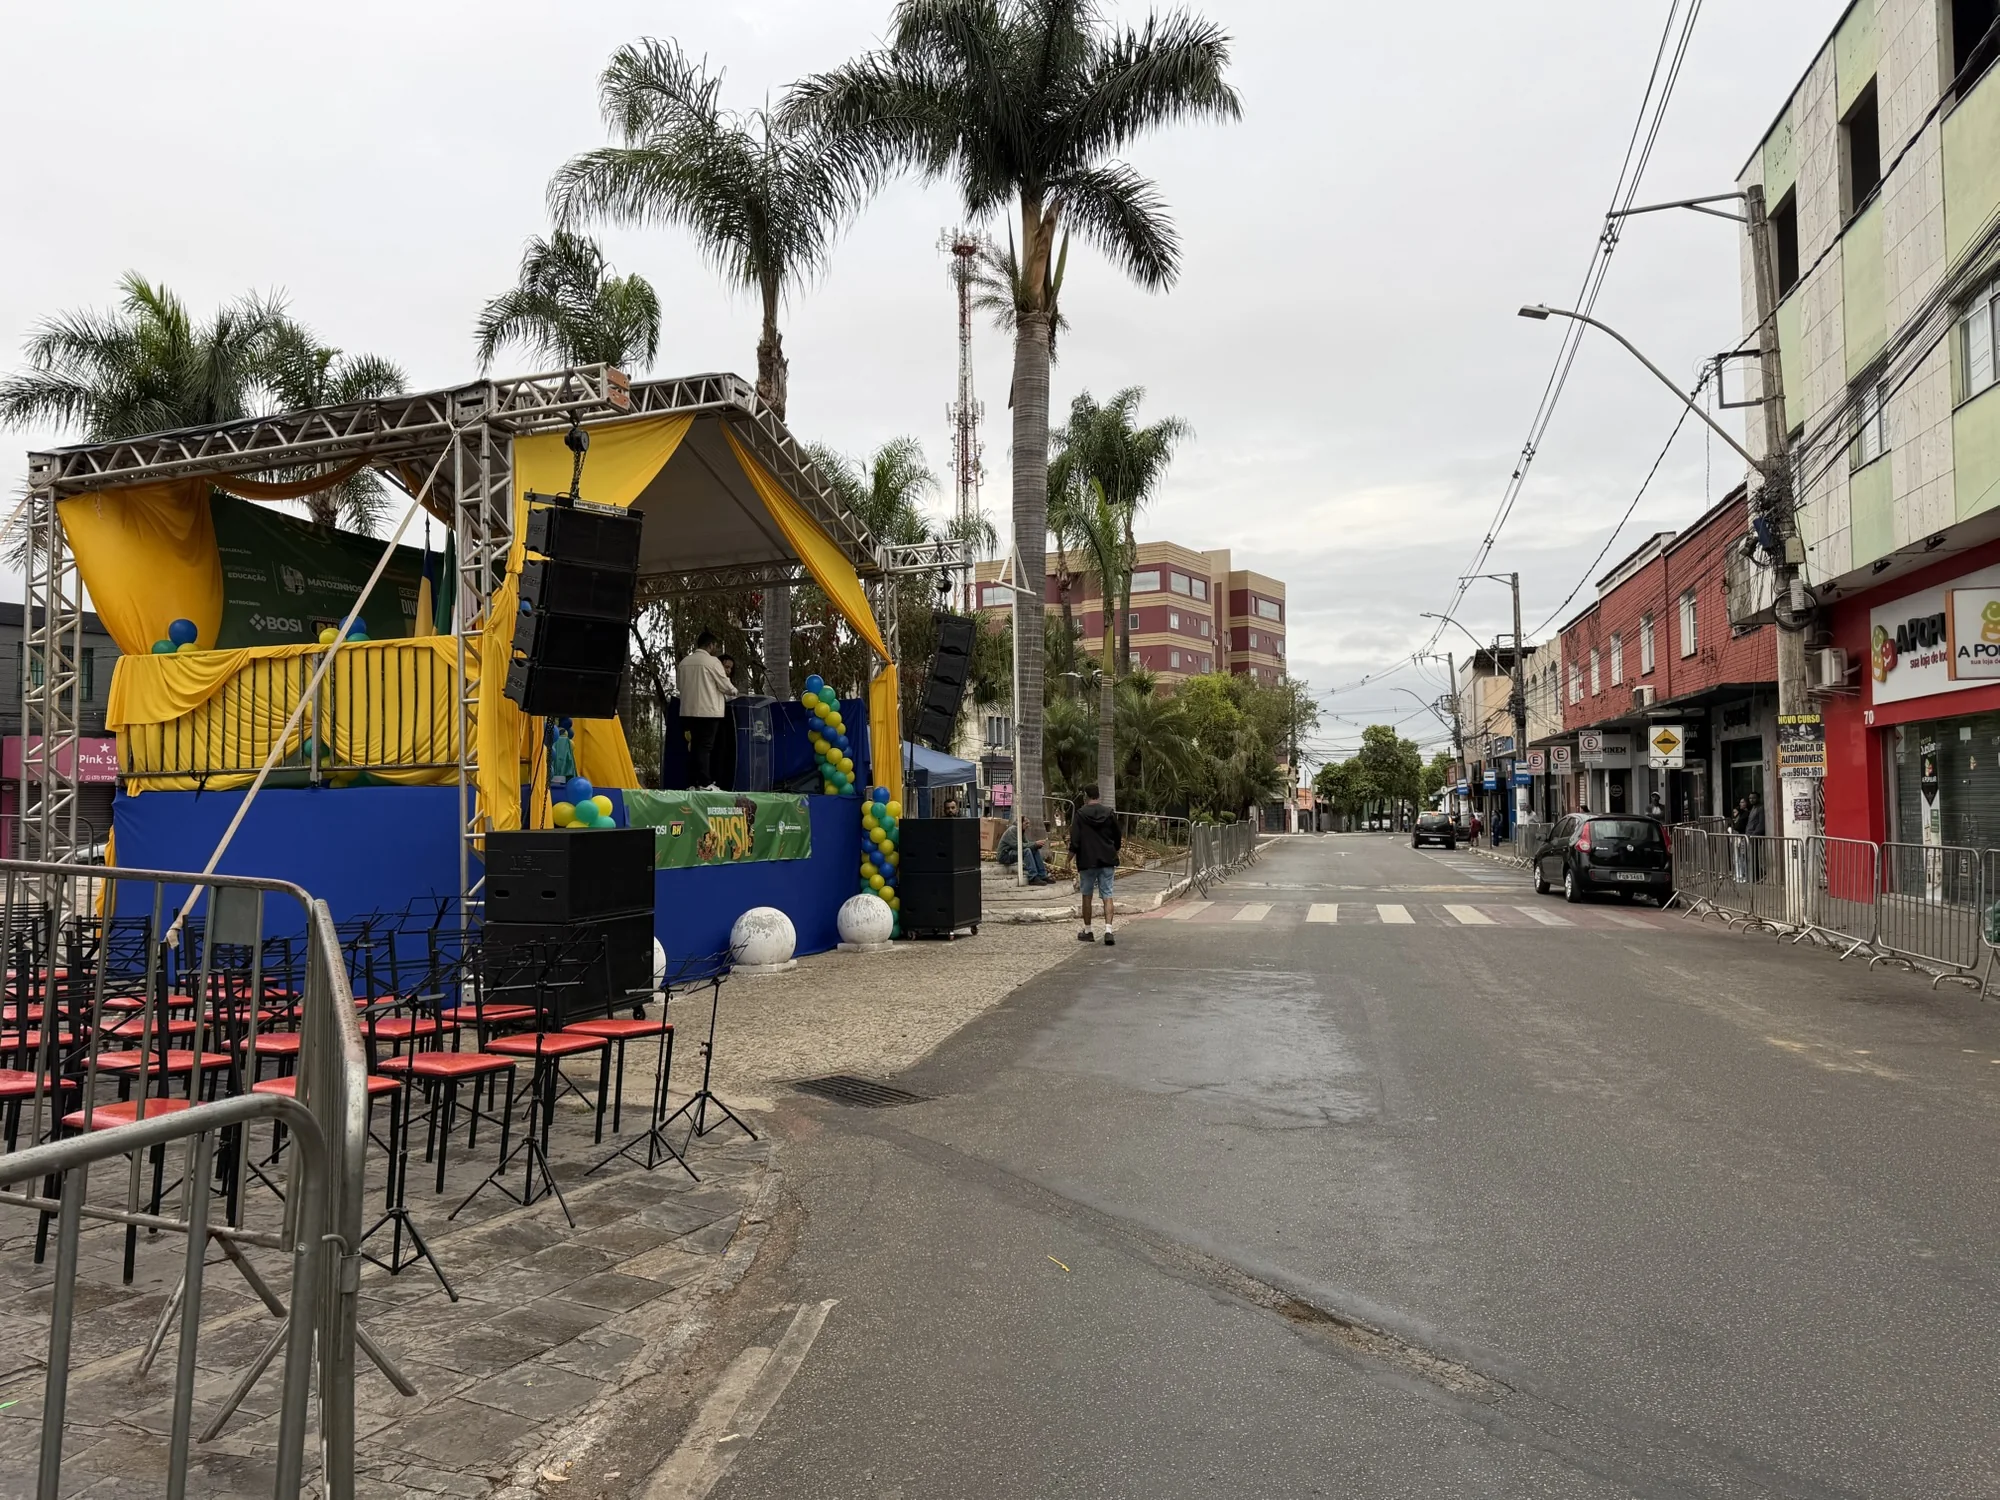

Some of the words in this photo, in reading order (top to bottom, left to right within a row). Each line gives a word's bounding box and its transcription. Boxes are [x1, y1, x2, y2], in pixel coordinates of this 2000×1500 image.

[227, 572, 267, 582] EDUCAÇÃO
[307, 578, 362, 593] MATOZINHOS
[266, 616, 303, 633] BOSI
[1958, 645, 1971, 658] A
[1910, 658, 1920, 669] sua
[1931, 651, 1939, 664] de
[1778, 715, 1797, 725] NOVO
[1797, 714, 1821, 724] CURSO
[1863, 710, 1875, 725] 70
[1587, 739, 1594, 747] E
[1780, 743, 1815, 753] MECÂNICA
[1815, 743, 1824, 752] DE
[79, 754, 104, 765] Pink
[106, 755, 118, 765] St
[1557, 750, 1565, 759] E
[1781, 753, 1824, 763] AUTOMÓVEIS
[1532, 756, 1539, 764] E
[1793, 767, 1823, 777] 99743-1611
[653, 825, 667, 835] OSI
